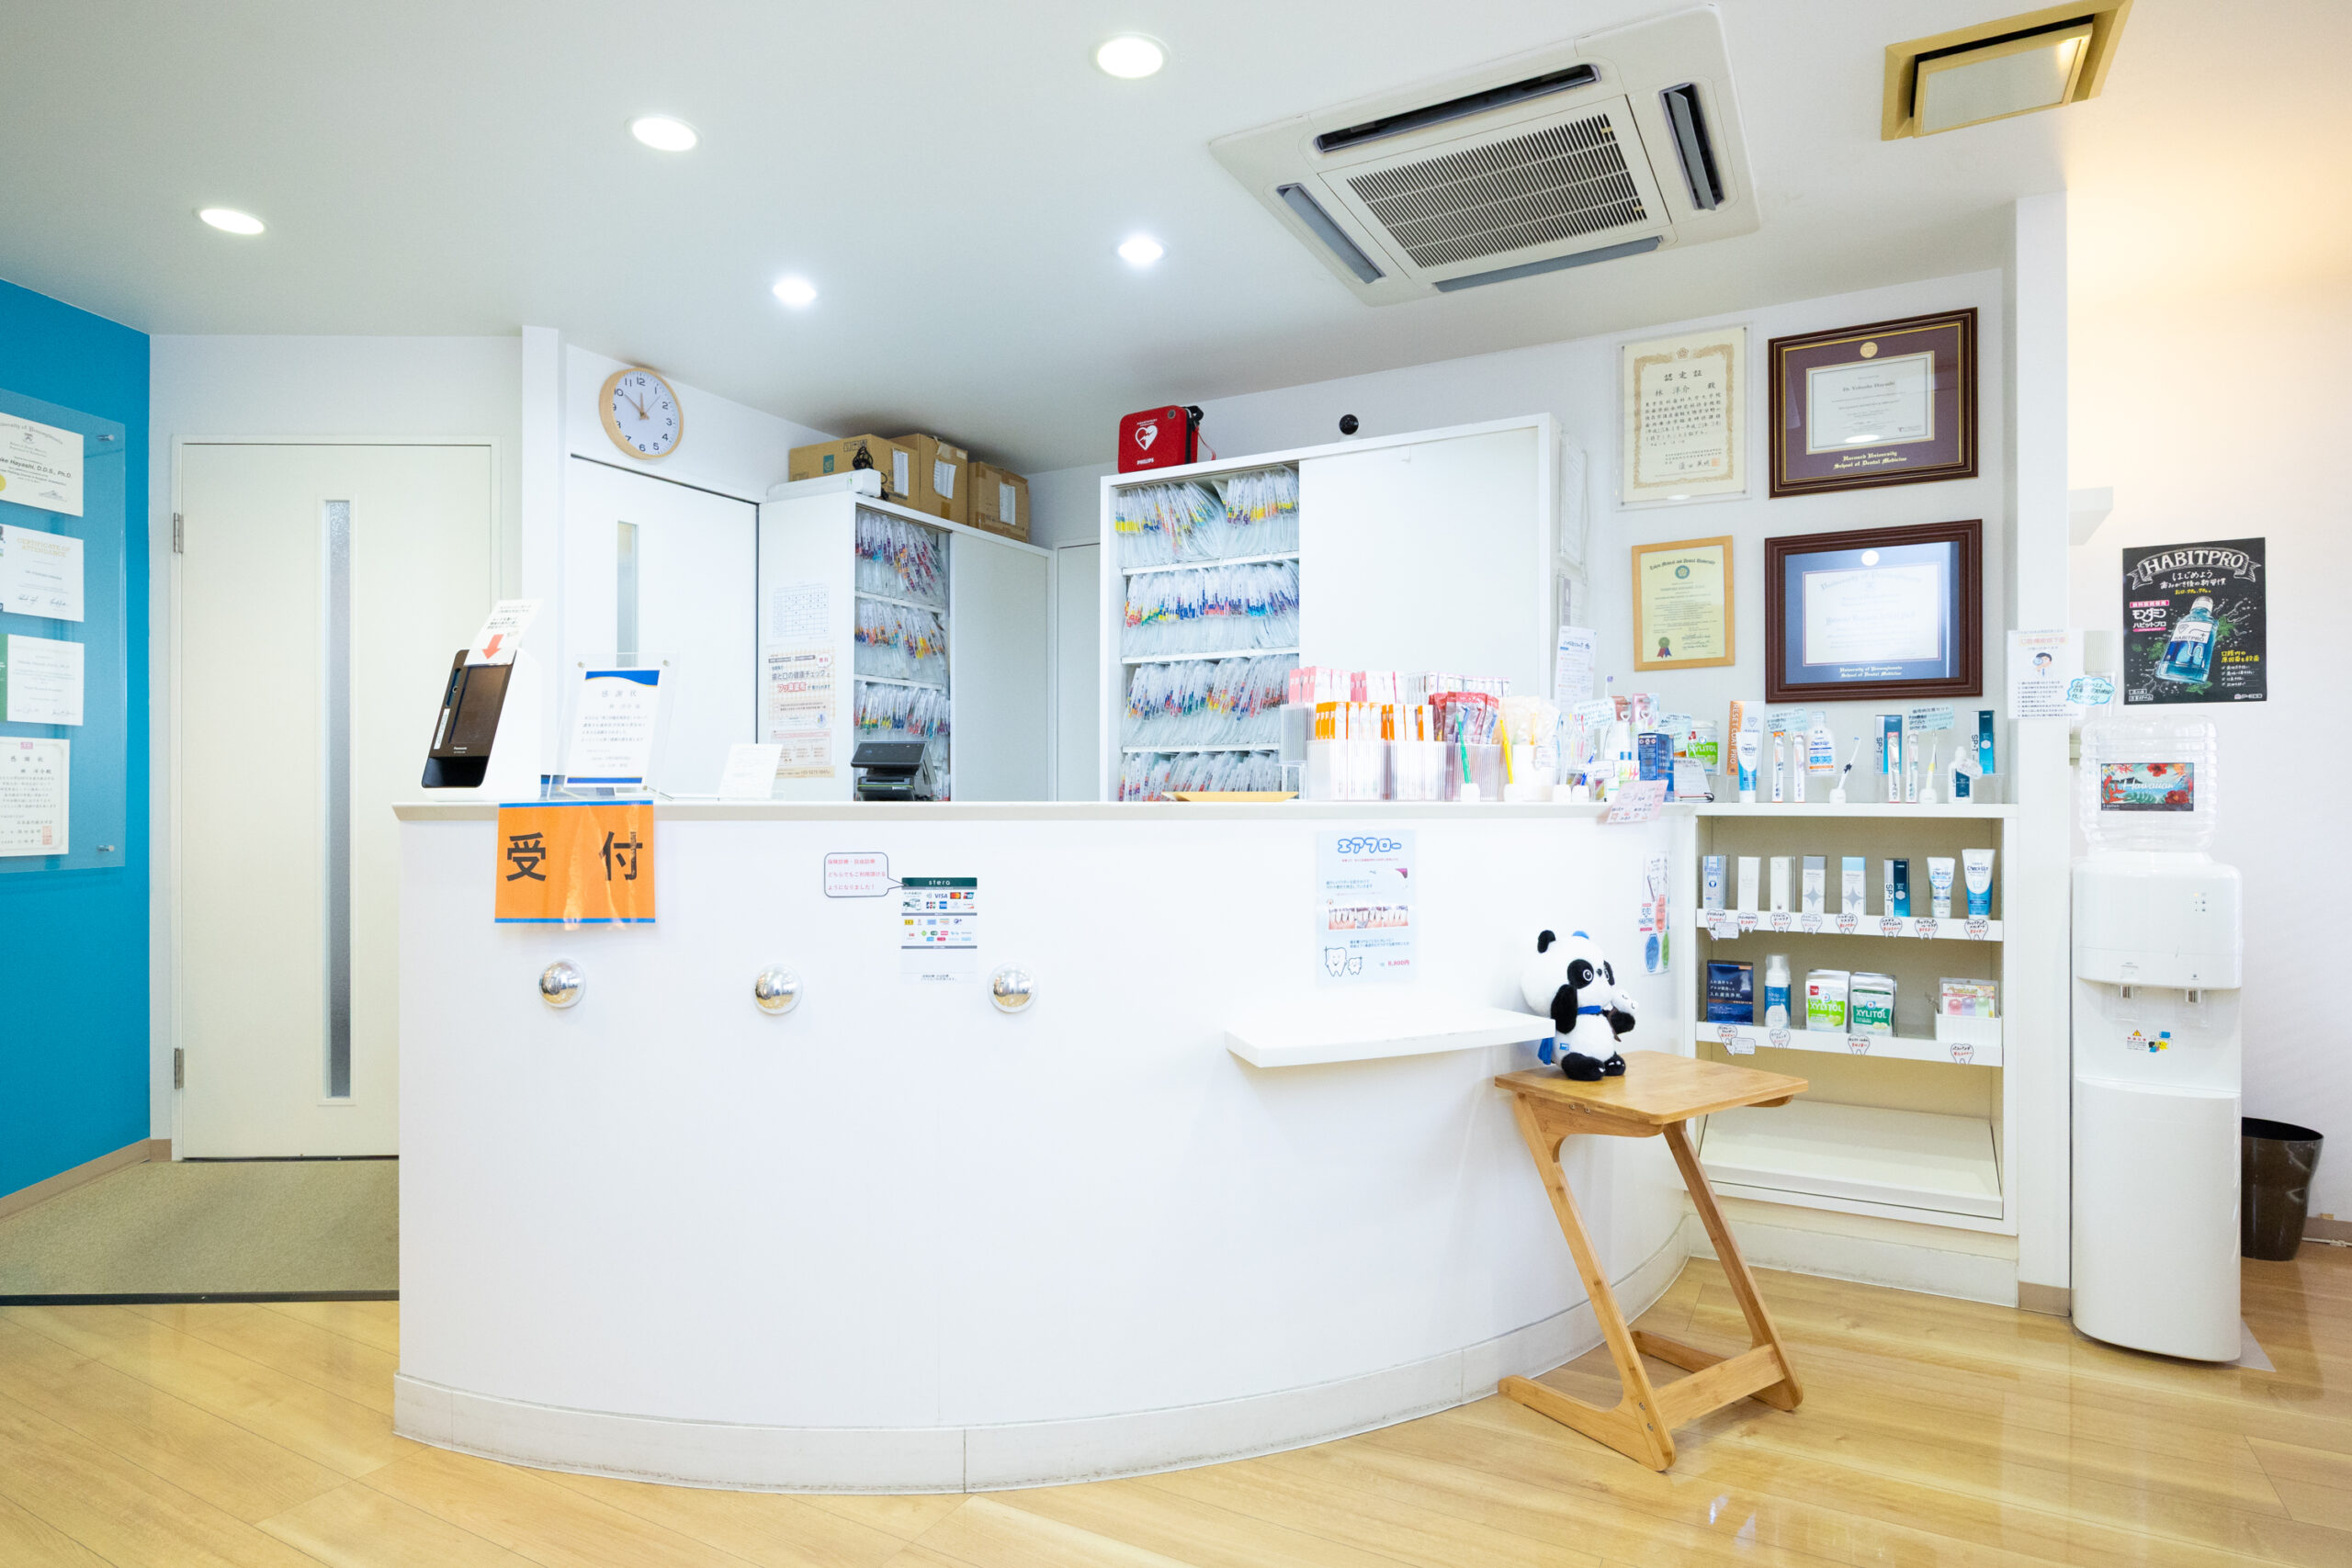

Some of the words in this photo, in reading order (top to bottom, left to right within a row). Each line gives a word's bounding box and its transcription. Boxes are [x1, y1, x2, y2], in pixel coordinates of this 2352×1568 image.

[625, 378, 632, 387] 11
[636, 377, 646, 387] 12
[614, 389, 624, 397] 10
[654, 387, 658, 395] 1
[662, 401, 669, 410] 2
[666, 418, 673, 426] 3
[662, 433, 668, 441] 4
[639, 444, 646, 452] 6
[2143, 549, 2244, 576] HABITPRO
[2172, 570, 2213, 581] はじめよう
[2132, 607, 2166, 623] モンダミン
[2132, 621, 2166, 629] ハビットプロ
[1338, 837, 1402, 854] エアフロー
[505, 830, 643, 882] 受付
[1810, 1002, 1843, 1012] XYLITOL
[1856, 1009, 1887, 1019] XYLITOL
